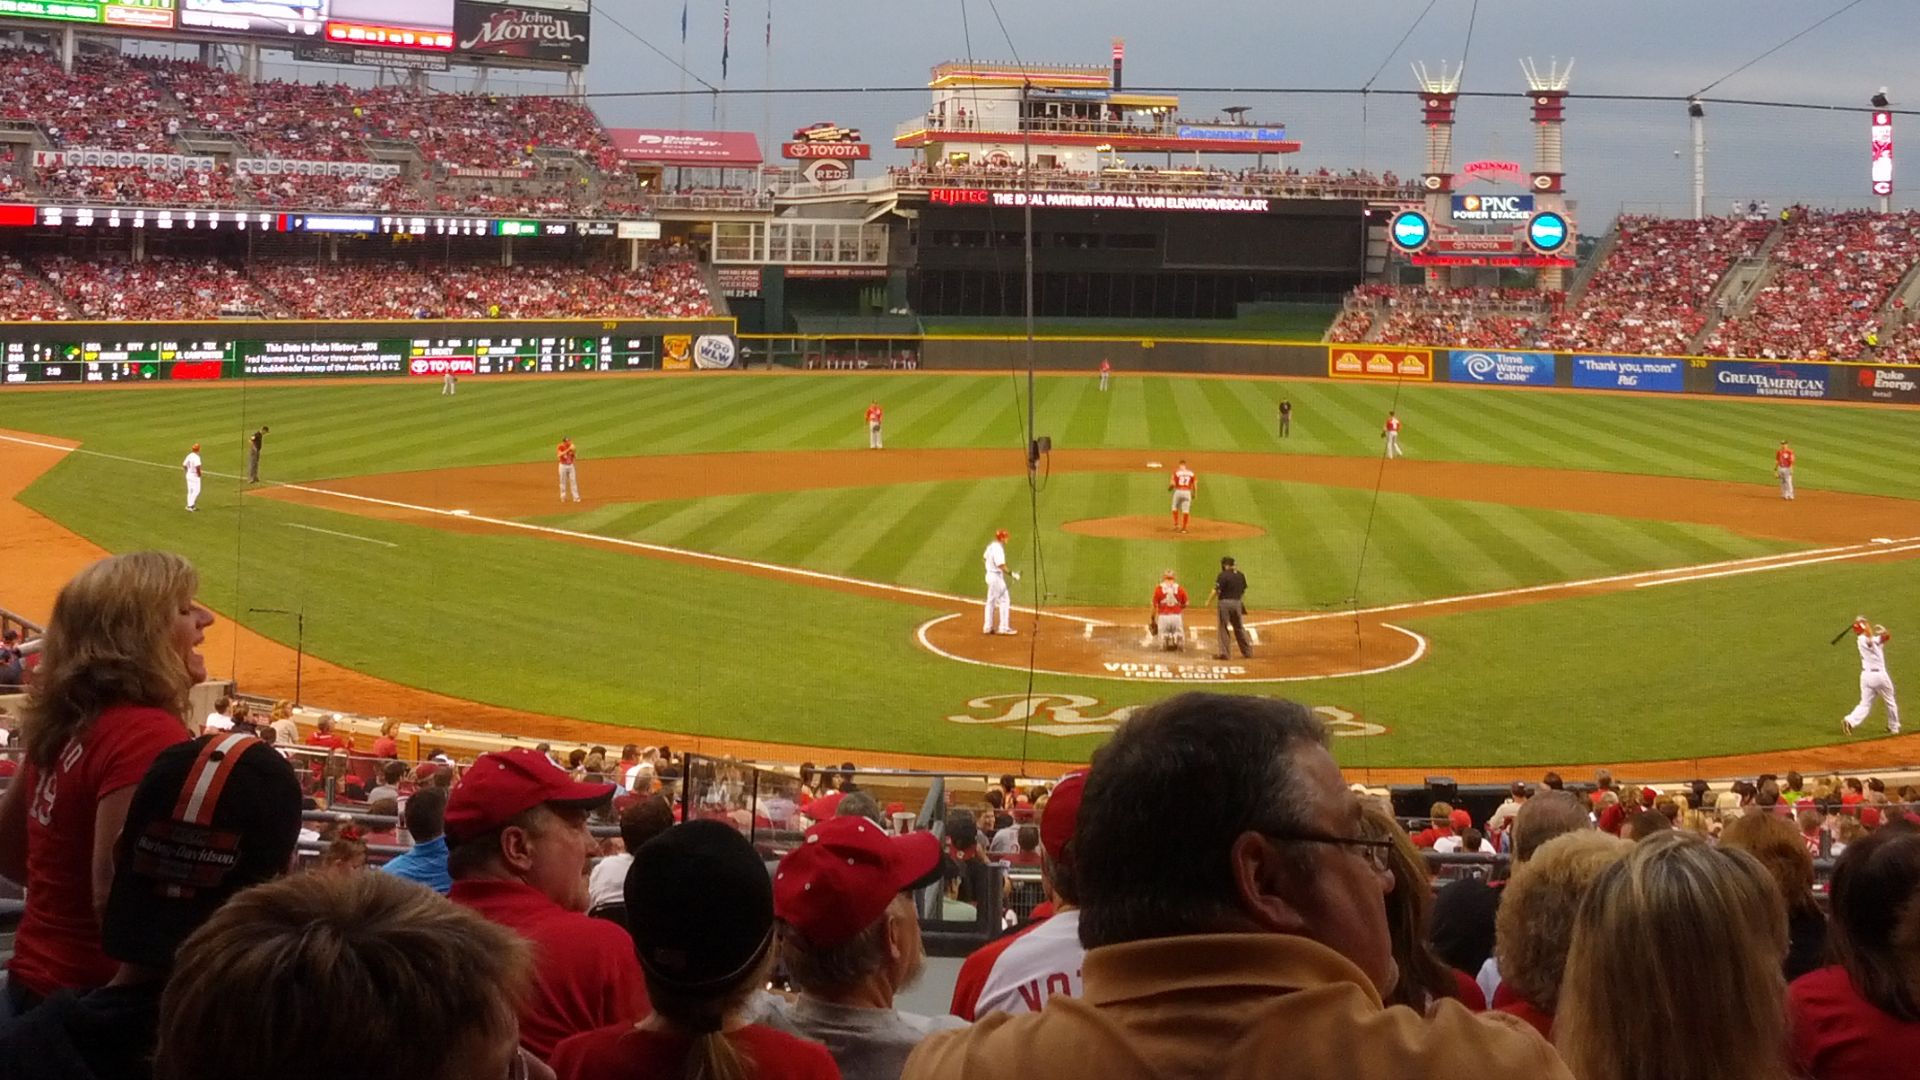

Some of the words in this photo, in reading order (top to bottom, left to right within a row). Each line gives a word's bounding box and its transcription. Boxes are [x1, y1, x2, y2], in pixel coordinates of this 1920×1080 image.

[516, 11, 553, 24] John
[460, 19, 585, 48] Morrell
[811, 145, 860, 155] TOYOTA
[816, 170, 848, 179] REDS
[931, 189, 988, 206] FUJITEC
[993, 193, 1013, 205] THE
[1015, 194, 1044, 206] IDAL
[1046, 194, 1092, 206] PARTNER
[1094, 195, 1115, 207] FOR
[1116, 196, 1135, 208] ALL
[1136, 197, 1165, 209] YOUR
[1481, 196, 1520, 212] PNC
[1453, 210, 1488, 220] POWER
[1491, 210, 1529, 220] STACKS
[265, 343, 282, 352] This
[283, 343, 301, 352] Date
[311, 343, 329, 352] Reds
[245, 355, 260, 363] Fred
[261, 355, 287, 363] Norman
[296, 354, 310, 363] Clay
[312, 354, 329, 363] Kirby
[330, 354, 348, 362] three
[349, 354, 379, 363] complete
[701, 345, 730, 362] WLW
[1496, 354, 1522, 364] Time
[258, 365, 303, 373] doubleheader
[429, 360, 473, 371] TOYOTA
[1496, 363, 1534, 373] Warner
[1579, 360, 1616, 371] "Thank
[1619, 363, 1642, 373] you,
[1644, 363, 1677, 373] mom"
[1875, 370, 1904, 380] Duke
[1757, 387, 1797, 396] INSURANCE
[1800, 390, 1824, 398] GROUP
[1104, 663, 1168, 672] VOTE
[1125, 671, 1225, 679] reds.com
